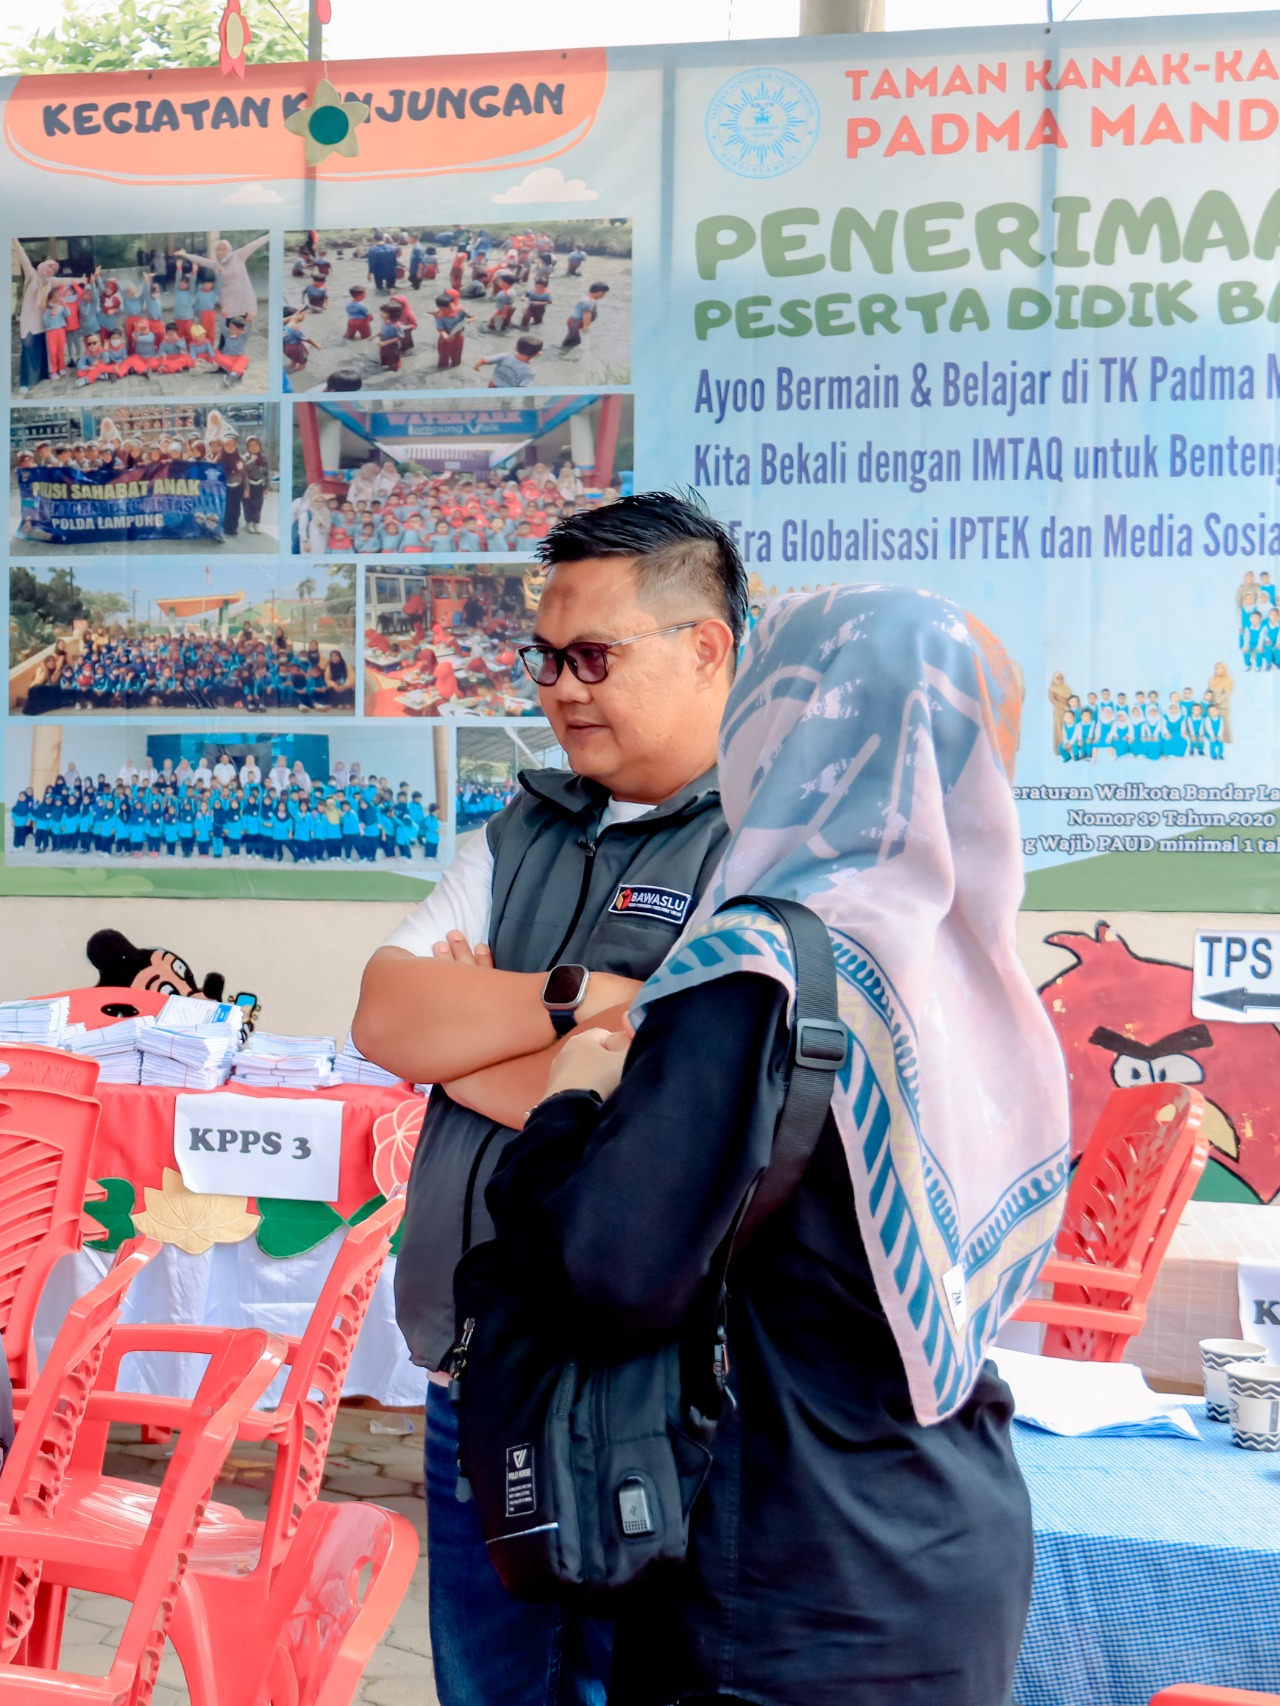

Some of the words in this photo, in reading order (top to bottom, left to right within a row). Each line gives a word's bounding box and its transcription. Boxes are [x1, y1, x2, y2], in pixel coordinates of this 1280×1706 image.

[845, 62, 1007, 100] TAMAN
[43, 96, 271, 137] KEGIATAN
[282, 83, 565, 124] KNJUNGAN
[846, 109, 1068, 159] PADMA
[1091, 99, 1280, 148] MAND
[694, 288, 990, 340] PESERTA
[1007, 279, 1198, 329] DIDIK
[694, 368, 766, 424] Ayoo
[776, 363, 899, 411] Bermain
[912, 362, 932, 407] &
[942, 360, 1052, 416] Belajar
[1061, 358, 1089, 404] di
[1099, 356, 1138, 403] TK
[1150, 354, 1255, 402] Padma
[694, 443, 750, 487] Kita
[761, 441, 847, 486] Bekali
[857, 440, 961, 493] dengan
[972, 436, 1064, 483] IMTAQ
[1074, 435, 1159, 480] untuk
[1169, 433, 1280, 486] Benten
[71, 481, 149, 500] SAHABAT
[153, 479, 201, 497] ANAK
[51, 517, 95, 530] POLDA
[98, 513, 164, 530] LAMPUNG
[782, 517, 938, 562] Globalisasi
[949, 516, 1030, 560] IPTEK
[1040, 515, 1093, 559] dan
[1103, 512, 1193, 558] Media
[1011, 784, 1092, 801] eraturan
[1095, 783, 1181, 801] Walikota
[1184, 783, 1255, 801] Bandar
[1067, 809, 1135, 827] Nomor
[1137, 811, 1160, 828] 39
[1163, 808, 1226, 827] Tahun
[1230, 812, 1276, 828] 2020
[1040, 835, 1094, 856] Wajib
[1097, 836, 1155, 853] PAUD
[1158, 835, 1240, 853] minimal
[1243, 838, 1254, 853] 1
[631, 892, 685, 911] BAWASLU
[1200, 935, 1273, 980] TPS
[188, 1127, 282, 1155] KPPS
[291, 1137, 312, 1160] 3
